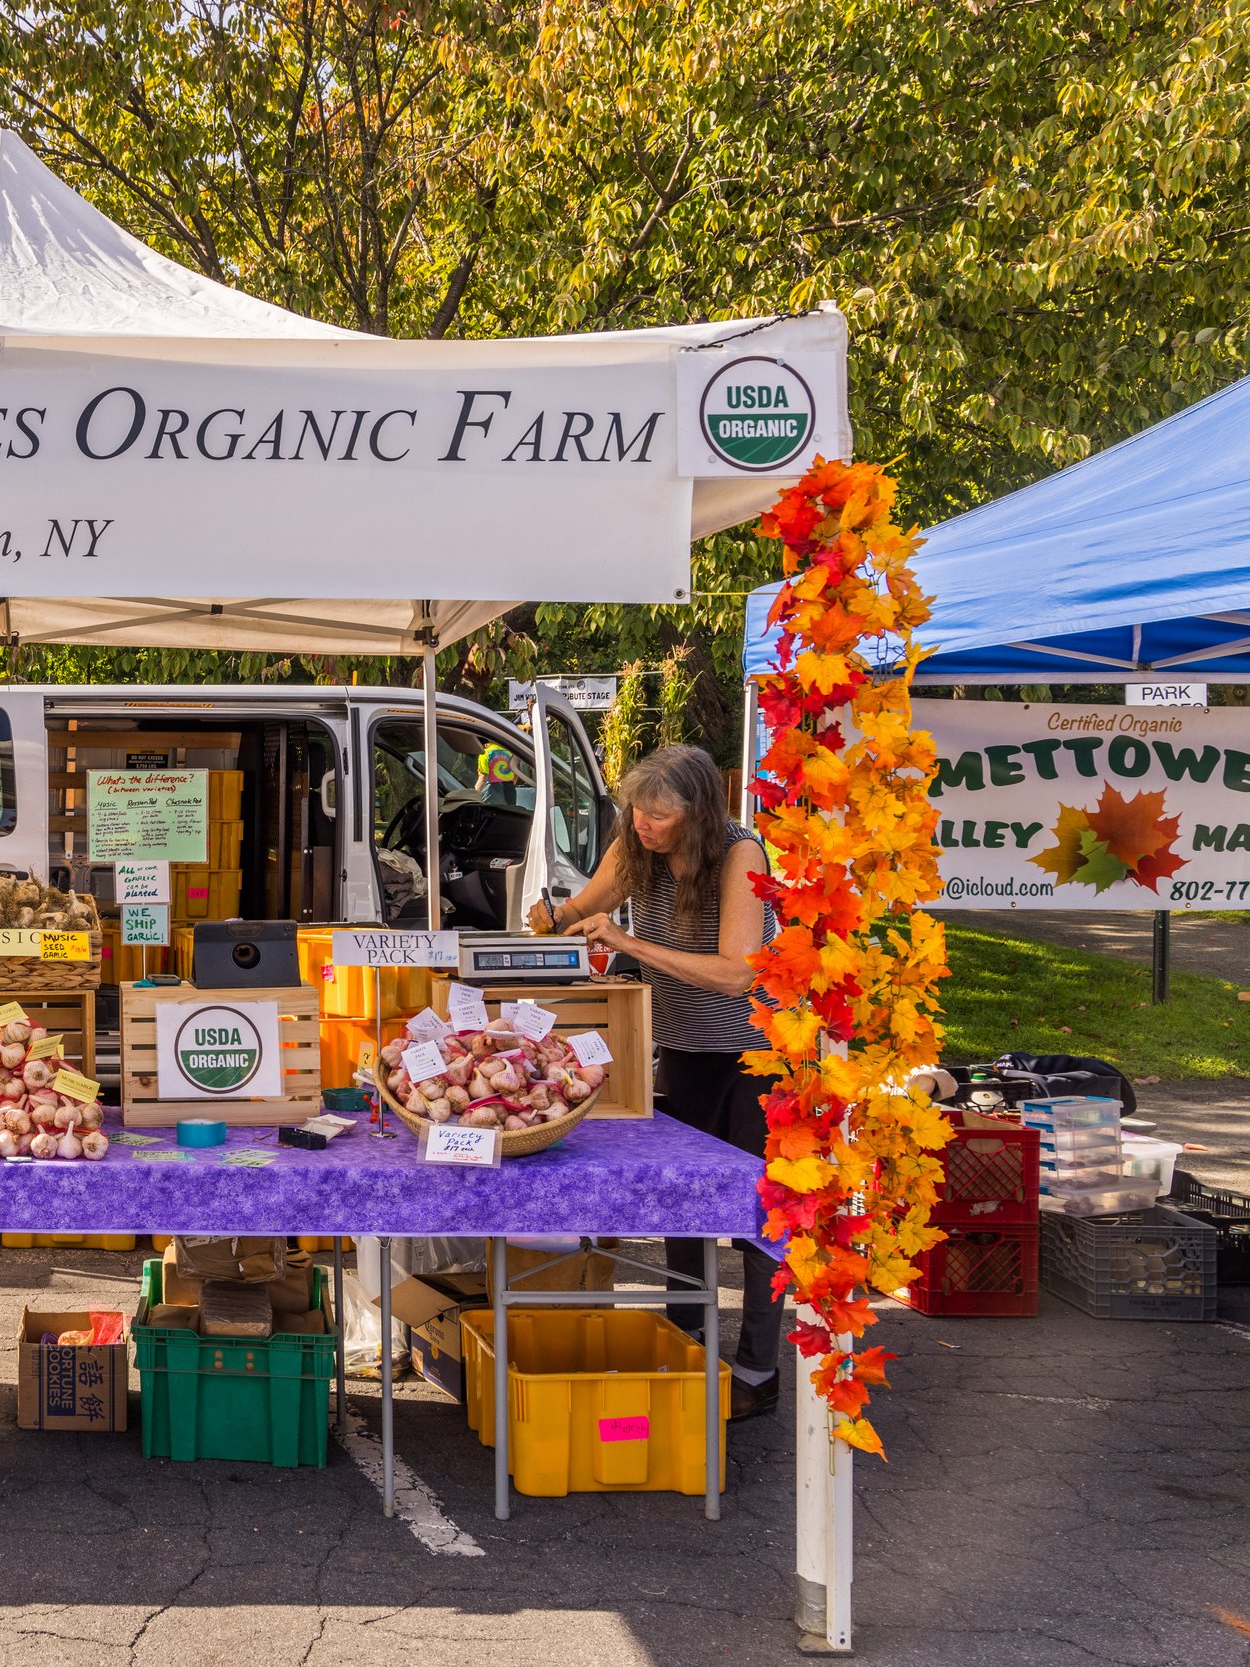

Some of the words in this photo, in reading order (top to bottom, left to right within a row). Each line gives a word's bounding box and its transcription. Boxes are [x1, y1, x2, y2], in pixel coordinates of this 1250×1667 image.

[725, 384, 790, 409] USDA
[75, 386, 417, 462] ORGANIC
[437, 389, 666, 463] FARM
[717, 417, 798, 438] ORGANIC
[39, 518, 115, 559] NY
[587, 692, 610, 700] STAGE
[1142, 685, 1191, 700] PARK
[1047, 712, 1117, 732] Certified
[1118, 714, 1182, 737] Organic
[97, 775, 126, 786] What's
[128, 776, 142, 784] the
[931, 820, 1044, 848] LLEY
[128, 908, 151, 917] WE
[353, 935, 436, 949] VARIETY
[367, 950, 418, 963] PACK
[195, 1028, 242, 1046] USDA
[189, 1054, 249, 1068] ORGANIC
[439, 1130, 484, 1144] Variety
[61, 1346, 73, 1408] ORTUNE
